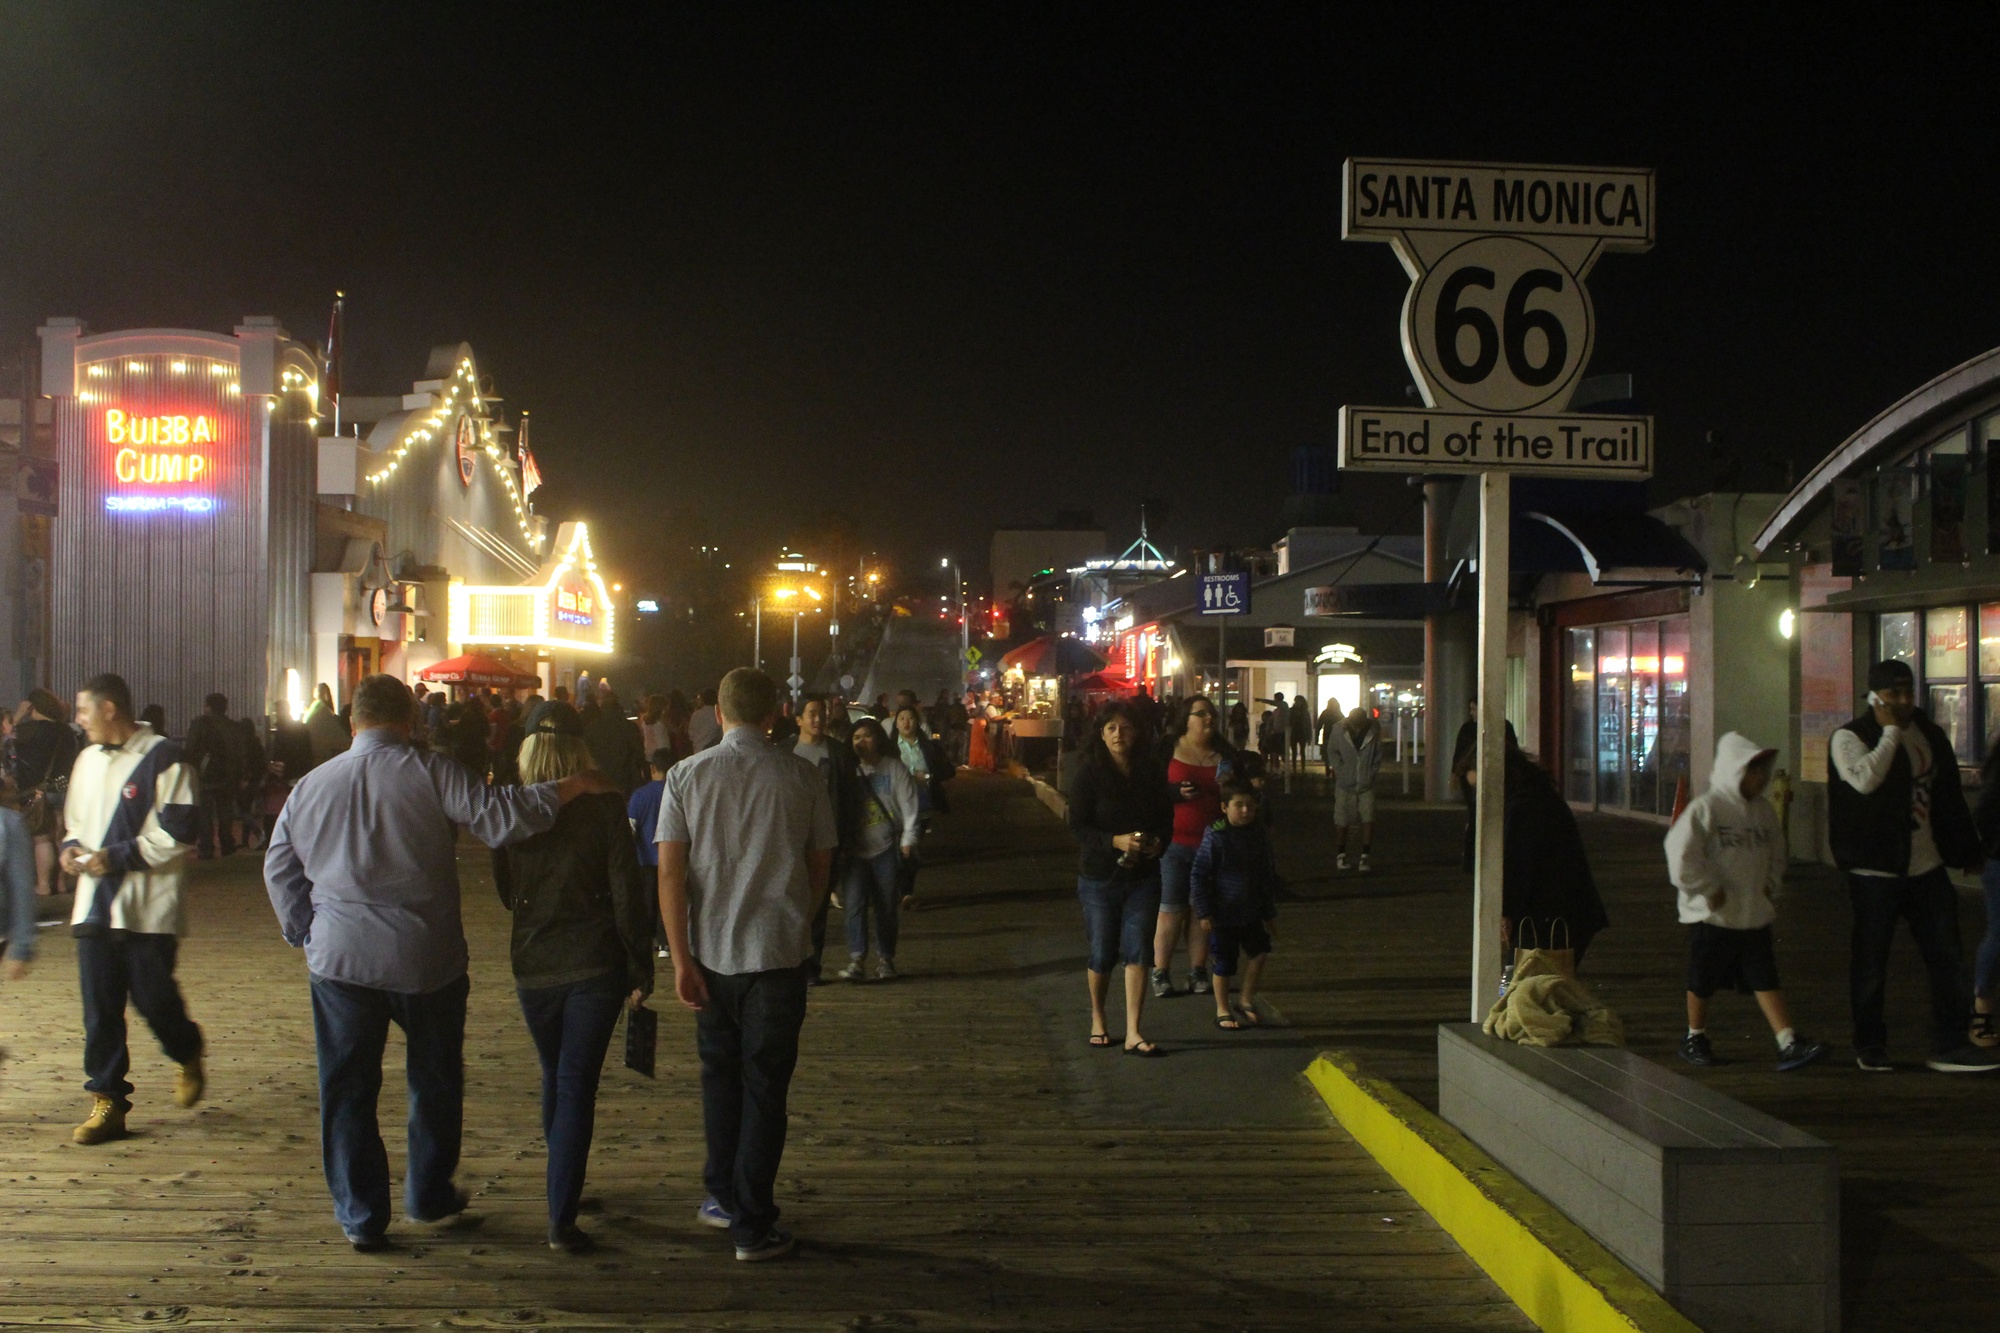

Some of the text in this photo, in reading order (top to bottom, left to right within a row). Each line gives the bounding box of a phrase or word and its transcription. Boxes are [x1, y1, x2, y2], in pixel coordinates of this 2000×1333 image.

[1360, 173, 1642, 227] SANTA MONICA
[1434, 266, 1568, 387] 66
[106, 409, 212, 445] BUBBA
[1361, 418, 1639, 462] End of the Trail
[116, 448, 206, 483] GUMP
[1203, 574, 1240, 583] RESTROOMS
